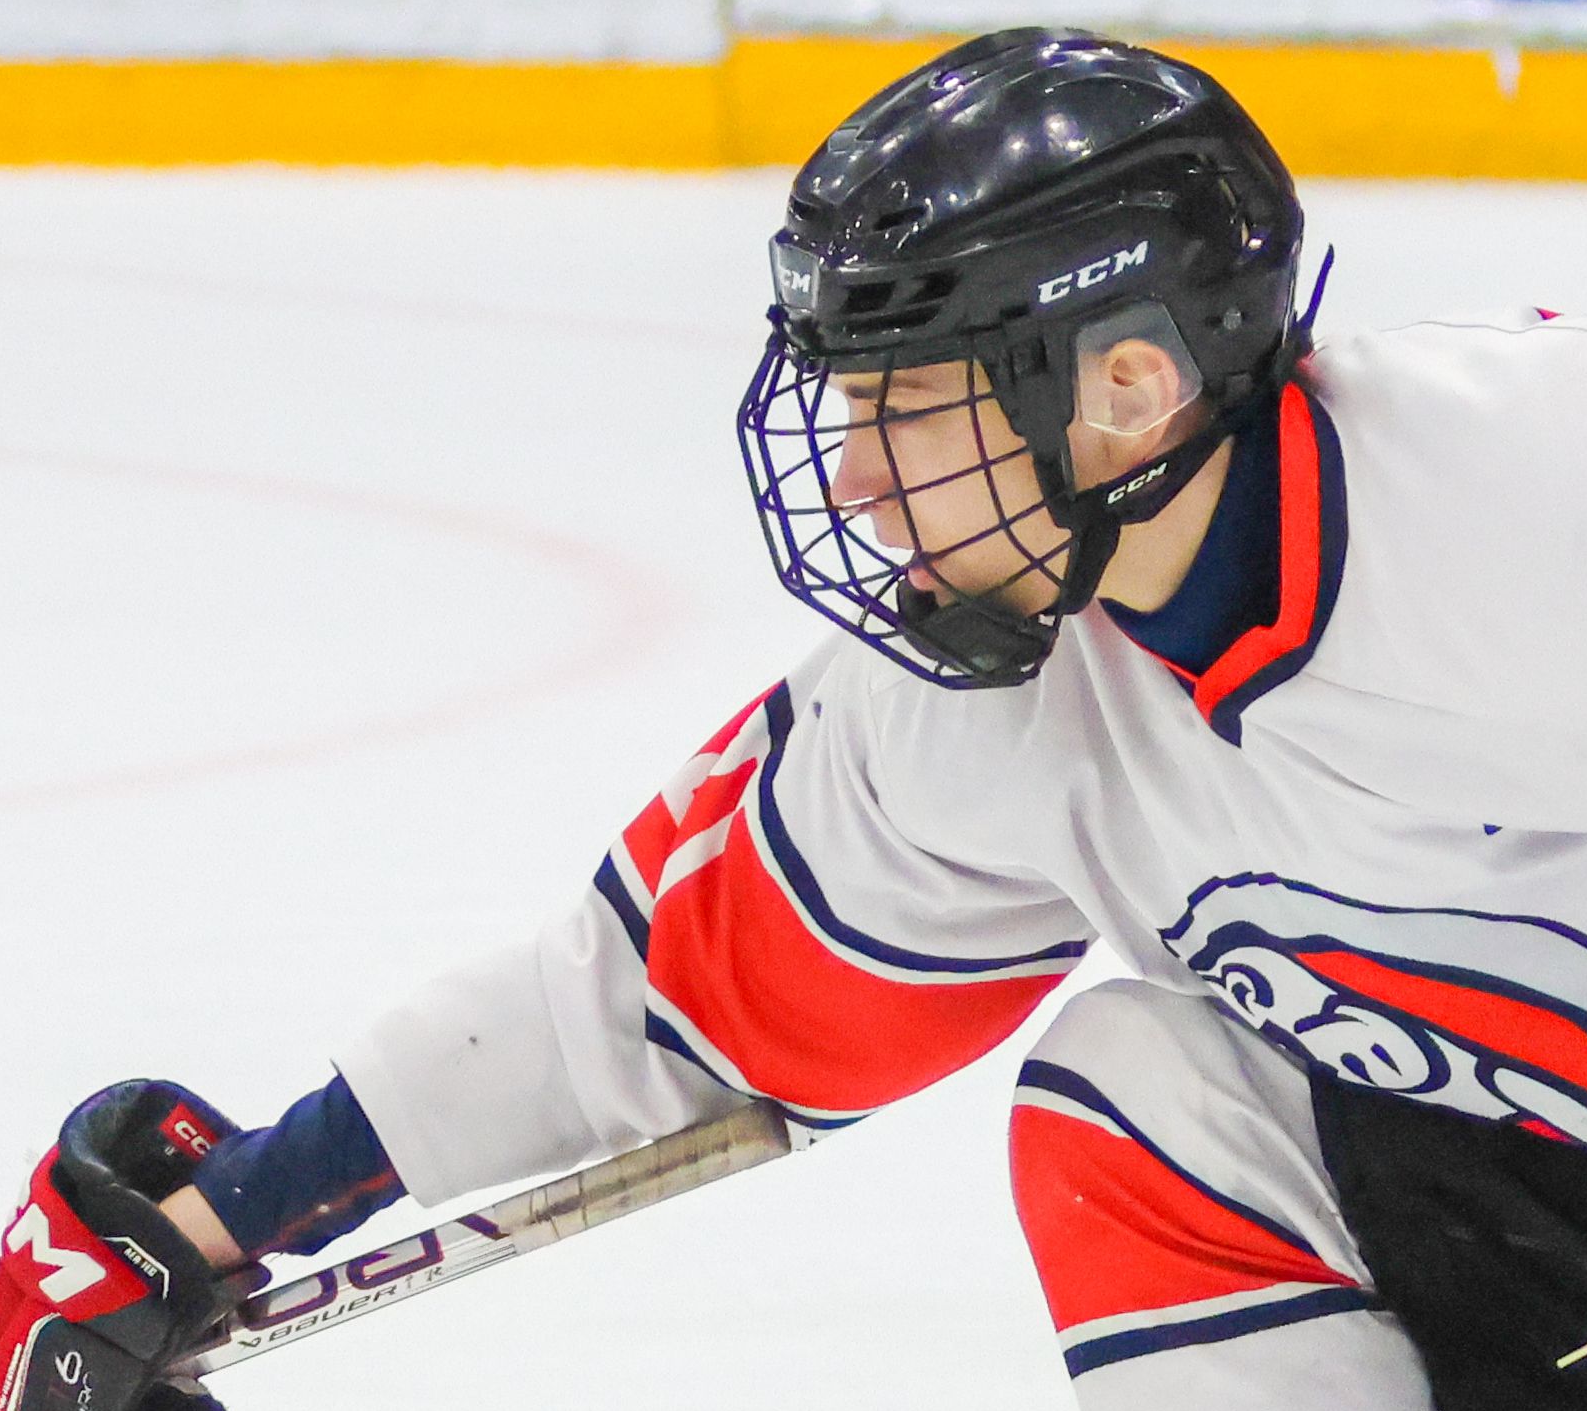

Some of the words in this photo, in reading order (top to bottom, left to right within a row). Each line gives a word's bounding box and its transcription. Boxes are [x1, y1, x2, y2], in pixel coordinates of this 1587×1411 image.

[1038, 240, 1151, 304] CCM
[1106, 462, 1169, 506] CCM
[173, 1118, 212, 1156] CC
